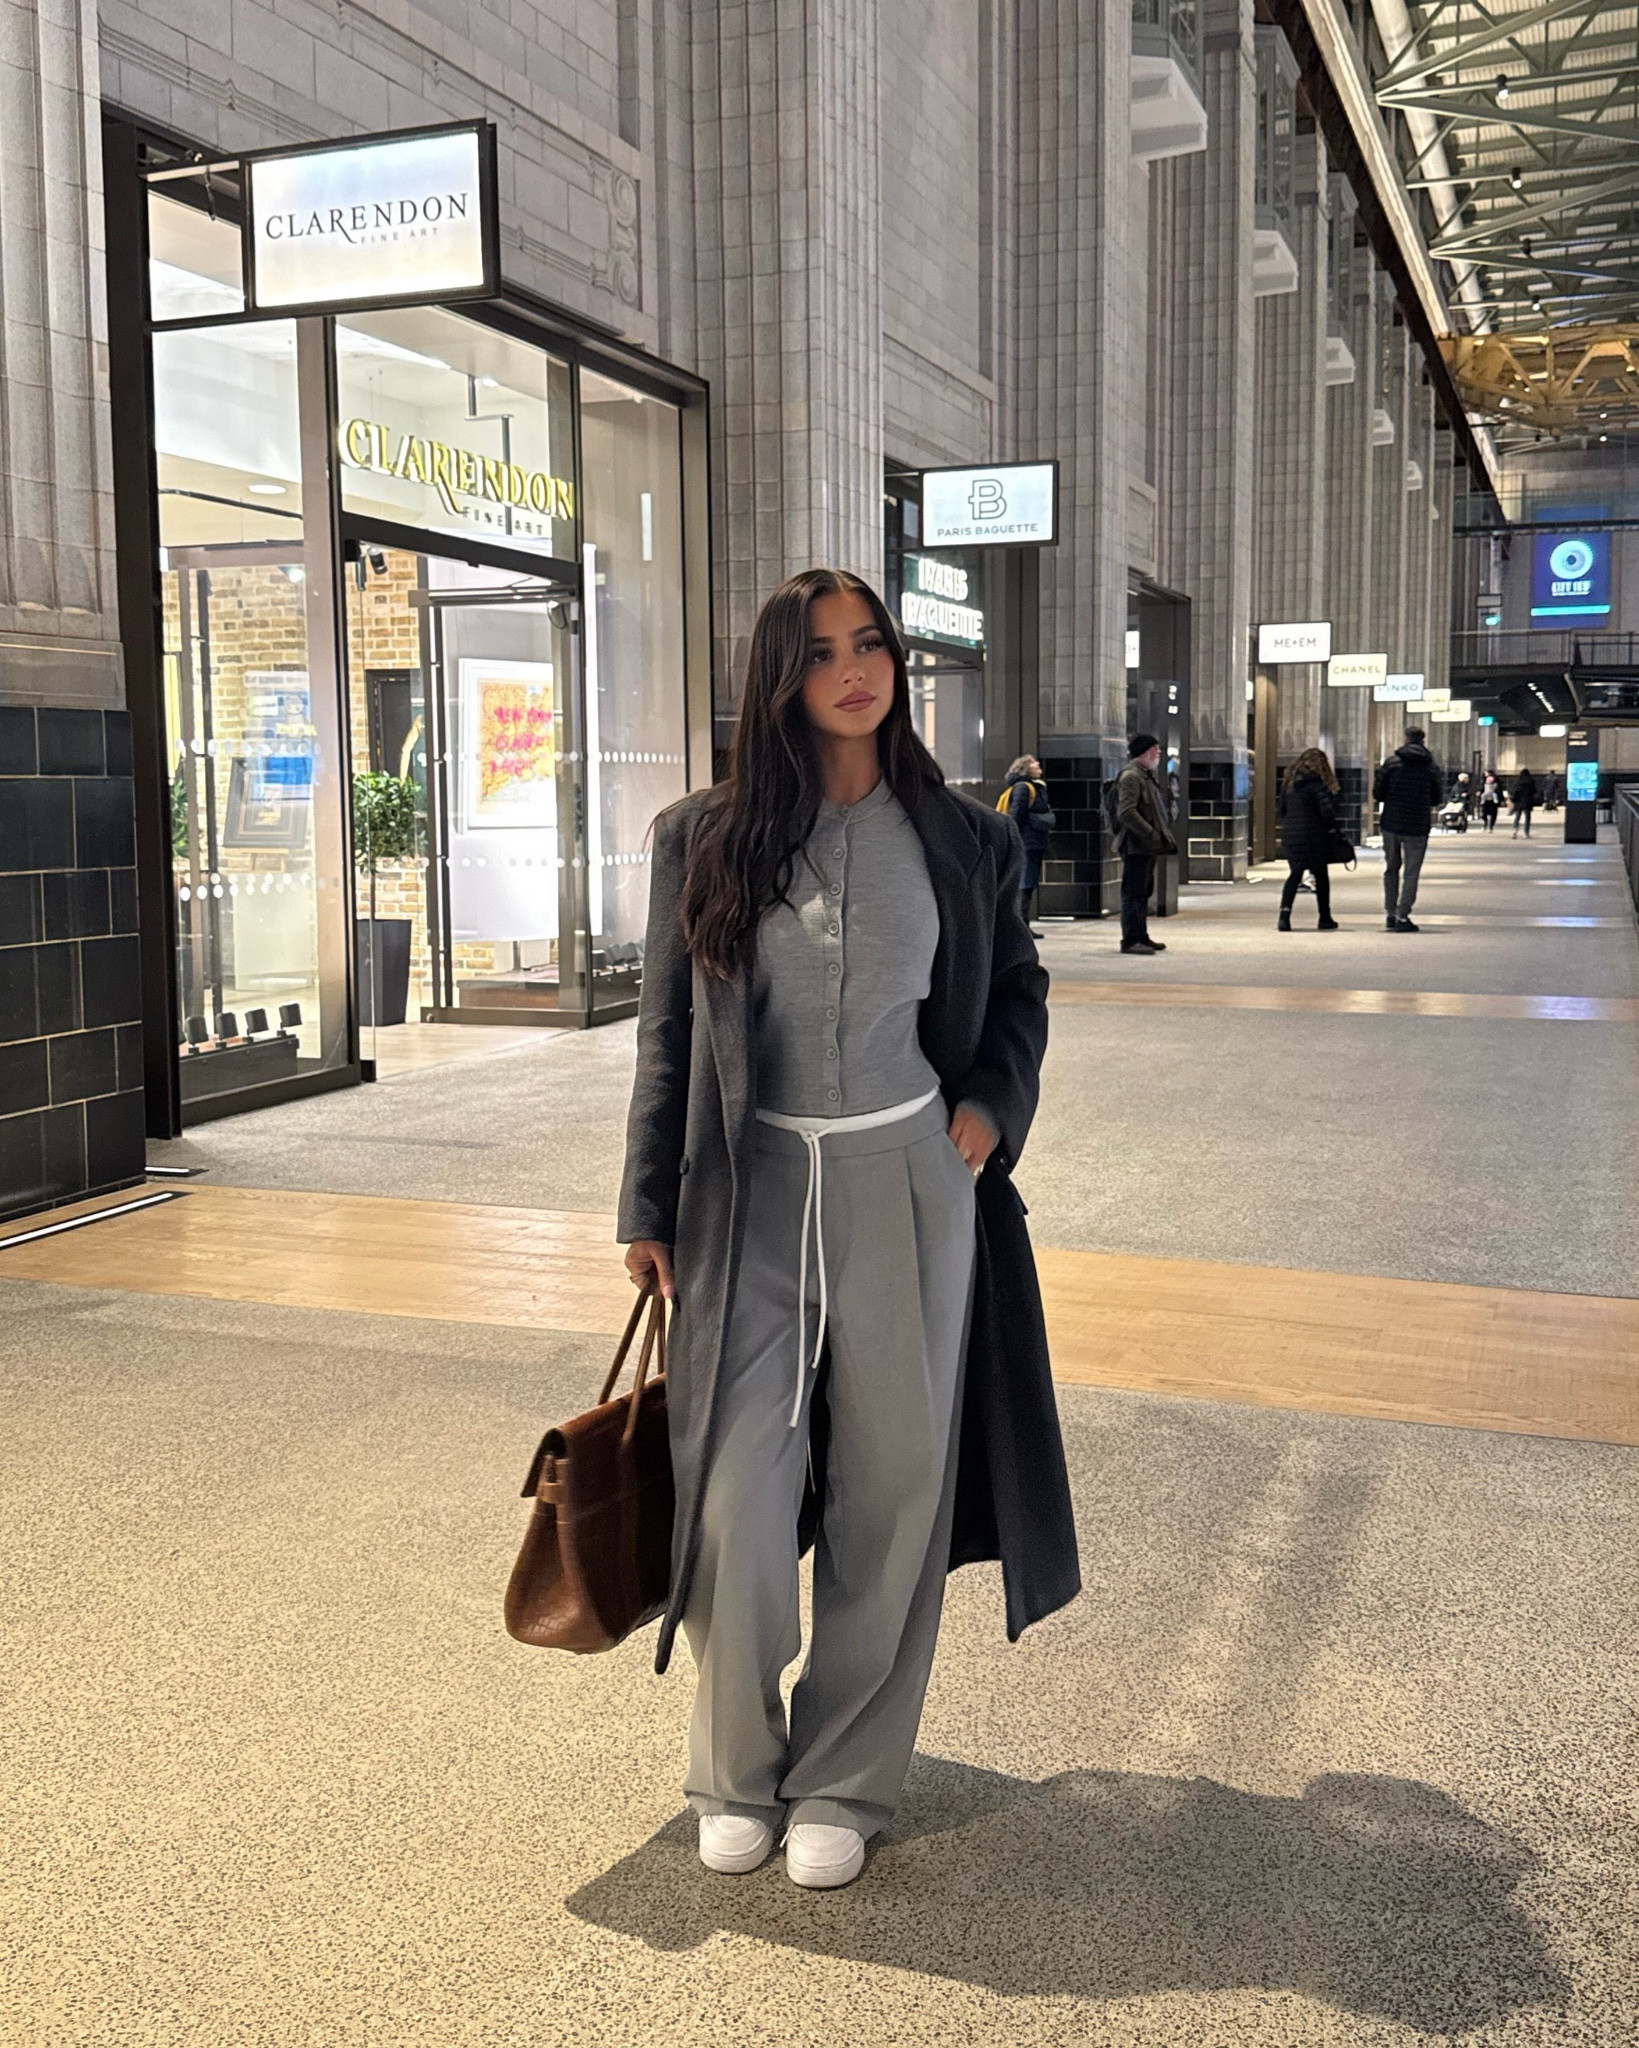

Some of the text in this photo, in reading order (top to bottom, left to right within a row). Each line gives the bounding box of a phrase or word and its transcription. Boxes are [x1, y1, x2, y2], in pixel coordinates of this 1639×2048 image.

[266, 193, 468, 244] CLARENDON
[361, 227, 438, 245] FINE ART
[338, 418, 573, 520] CLARENDON
[462, 506, 543, 536] FINE ART
[937, 523, 1038, 537] PARIS BAGUETTE
[918, 557, 968, 601] PARIS
[901, 591, 984, 640] BAGUETTE
[1274, 637, 1317, 648] ME+EM
[1332, 665, 1381, 675] CHANEL
